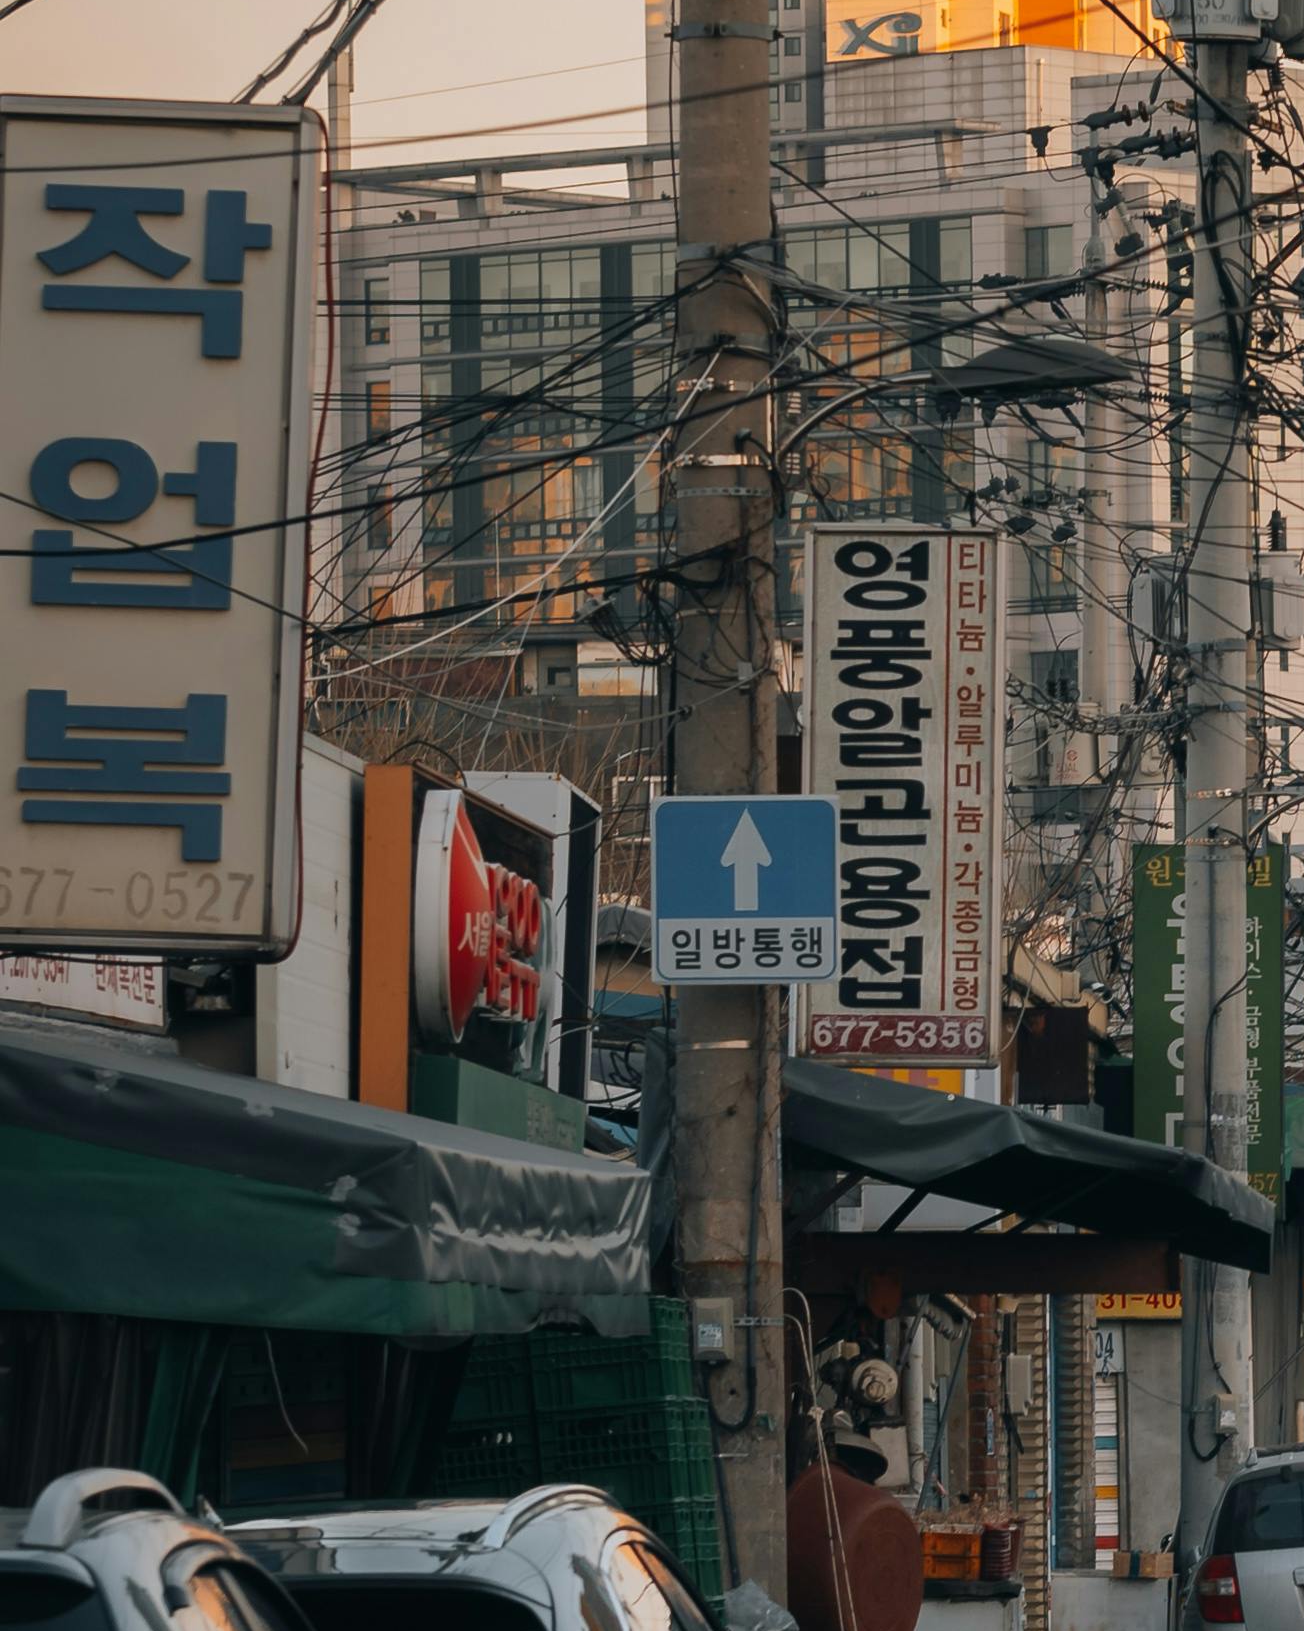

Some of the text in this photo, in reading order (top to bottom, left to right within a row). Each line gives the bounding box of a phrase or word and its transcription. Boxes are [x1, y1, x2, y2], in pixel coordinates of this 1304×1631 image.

[18, 182, 273, 863] 작업복
[830, 540, 933, 1009] 영풍알곤용접
[671, 926, 823, 971] 일방통행
[813, 1019, 985, 1050] 677-5356
